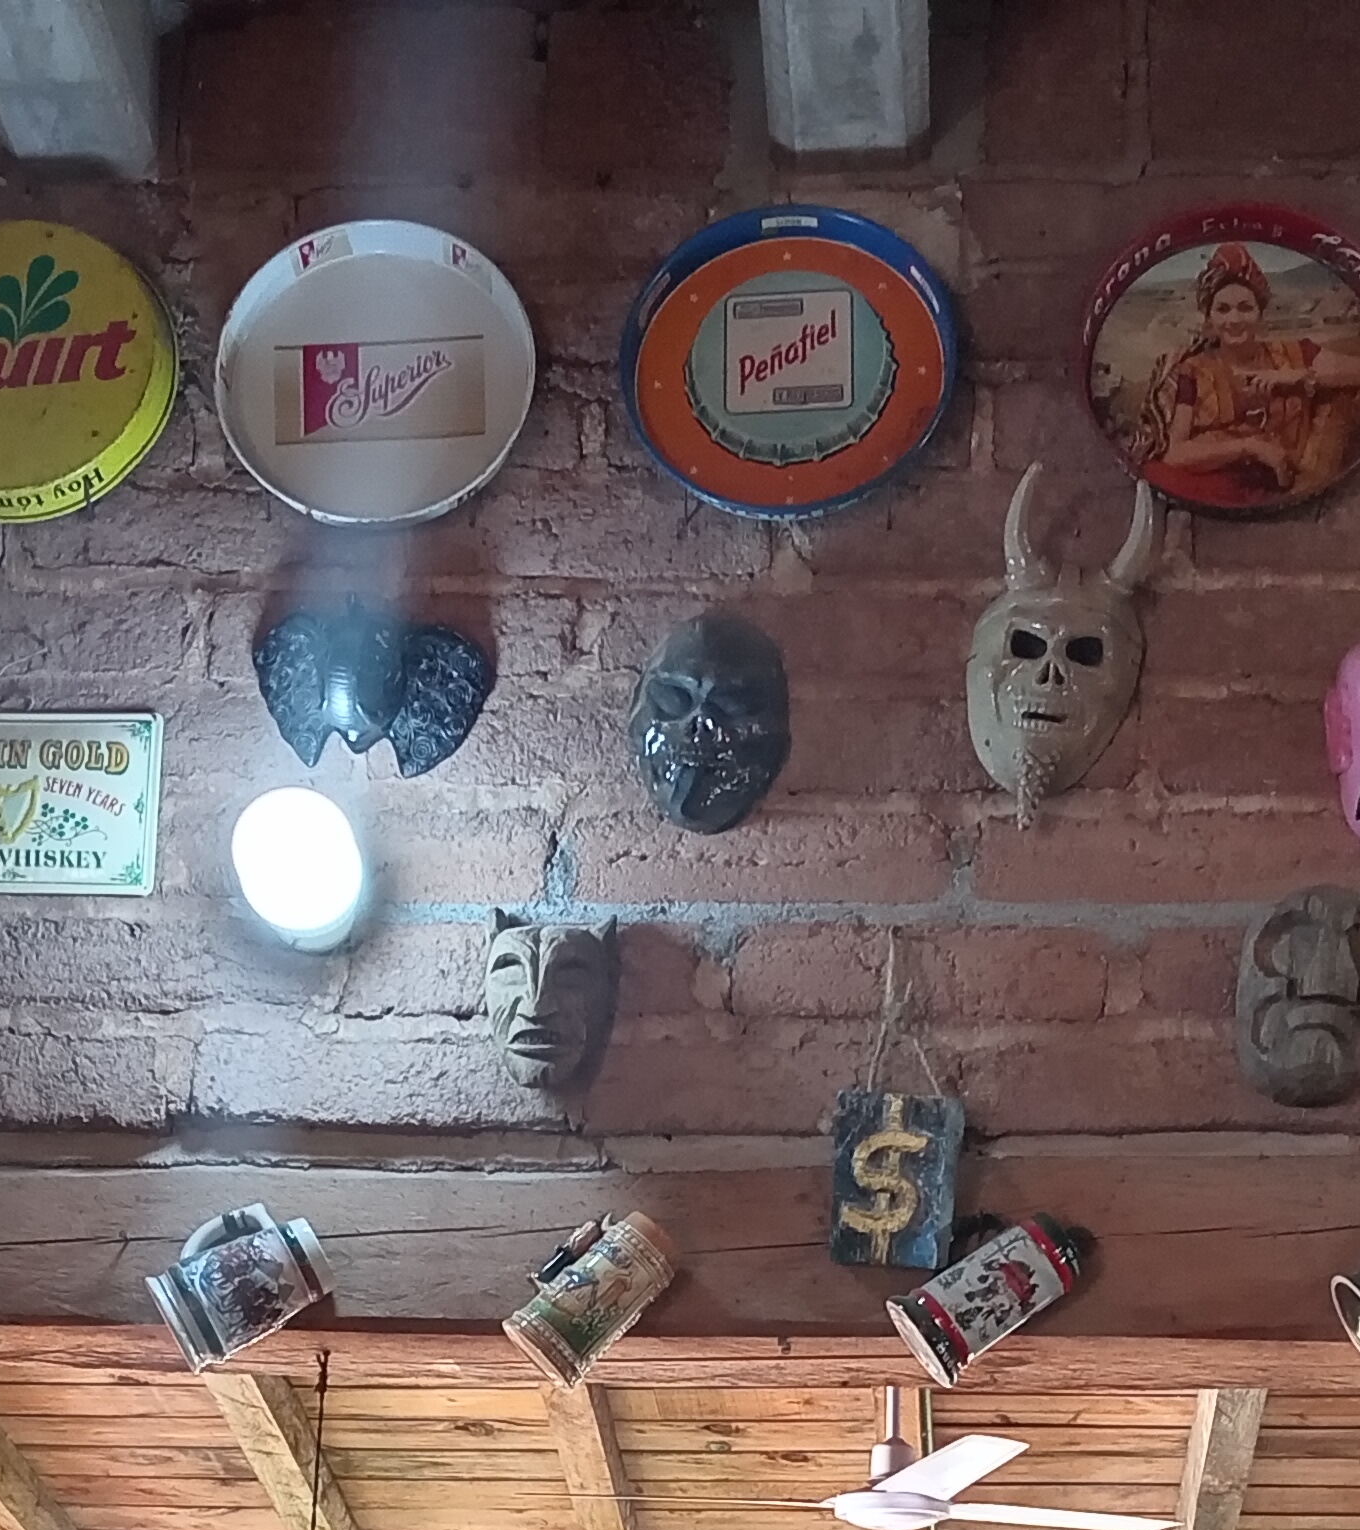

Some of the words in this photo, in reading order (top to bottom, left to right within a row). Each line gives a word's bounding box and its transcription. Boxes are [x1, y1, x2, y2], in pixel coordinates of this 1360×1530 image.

[738, 308, 837, 397] Peñafiel
[326, 350, 455, 429] Superior
[38, 739, 130, 776] GOLD
[43, 775, 85, 799] SEVEN
[85, 786, 127, 818] YEARS
